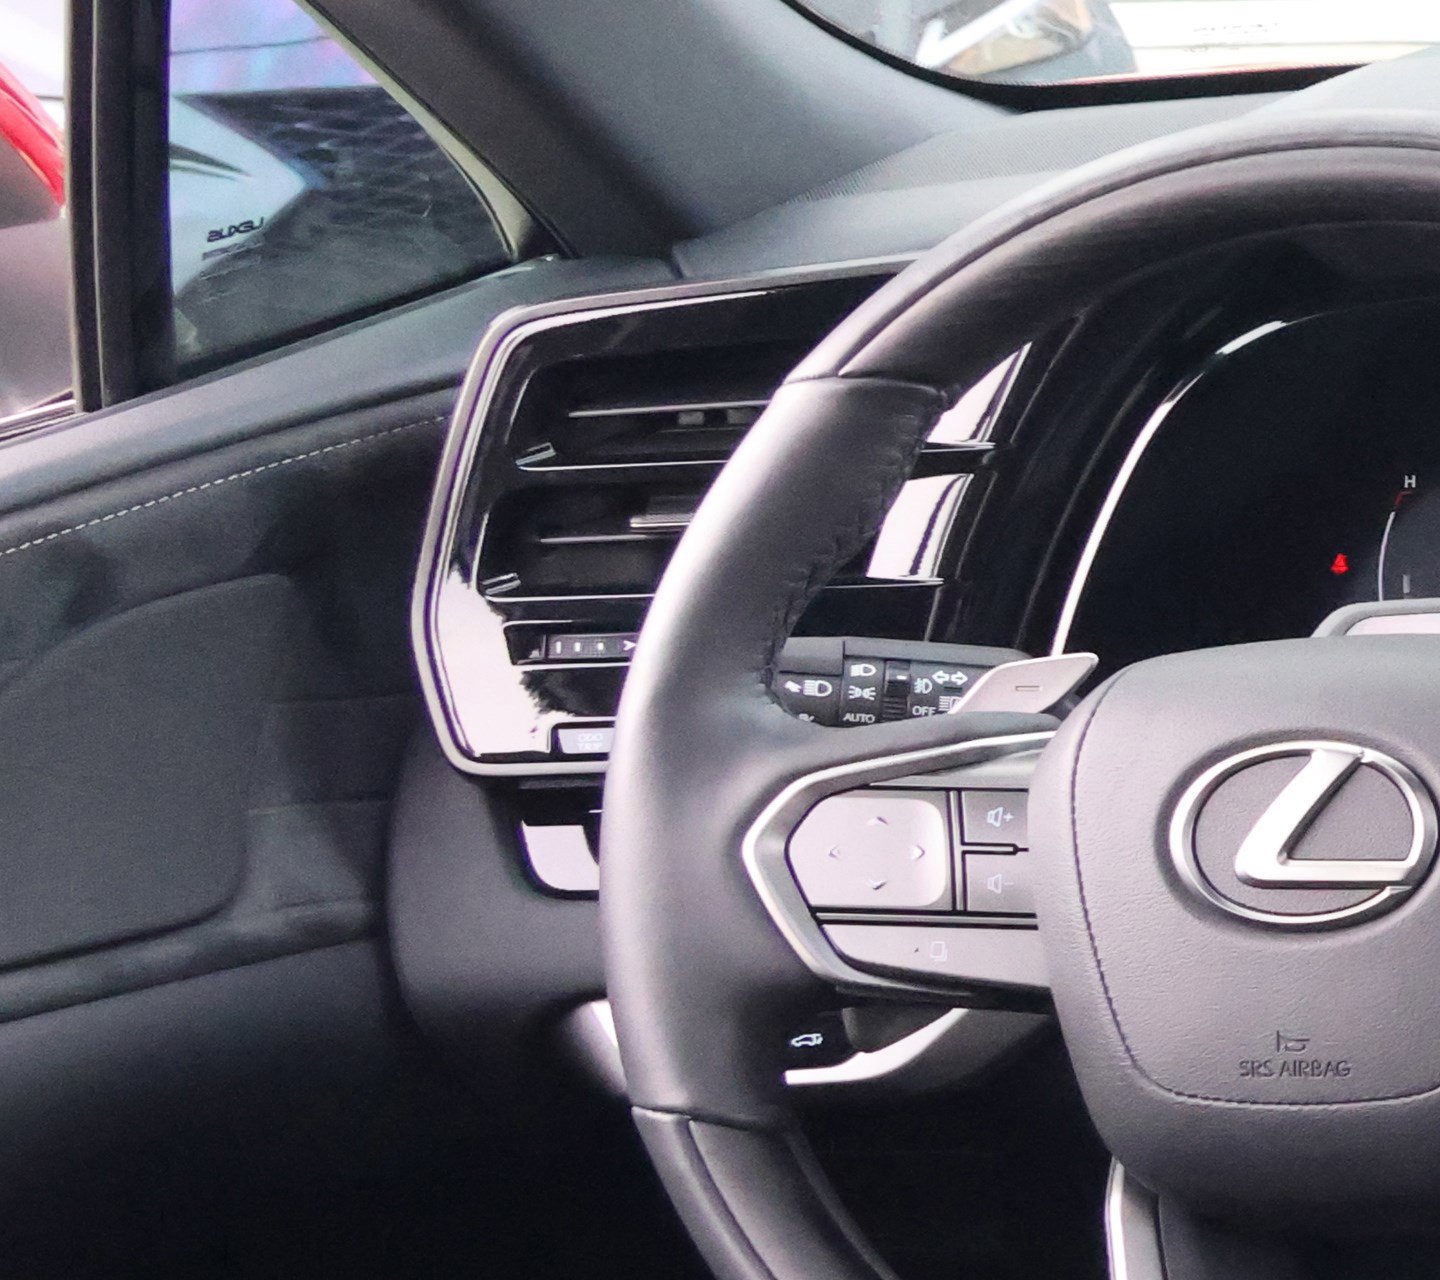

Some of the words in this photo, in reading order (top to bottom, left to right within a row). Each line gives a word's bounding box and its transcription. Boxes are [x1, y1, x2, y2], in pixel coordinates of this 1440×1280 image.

[1404, 474, 1417, 489] H
[912, 705, 937, 717] OFF
[843, 713, 876, 724] AUTO
[1239, 1060, 1275, 1078] SRS
[1279, 1060, 1353, 1078] AIRBAG
